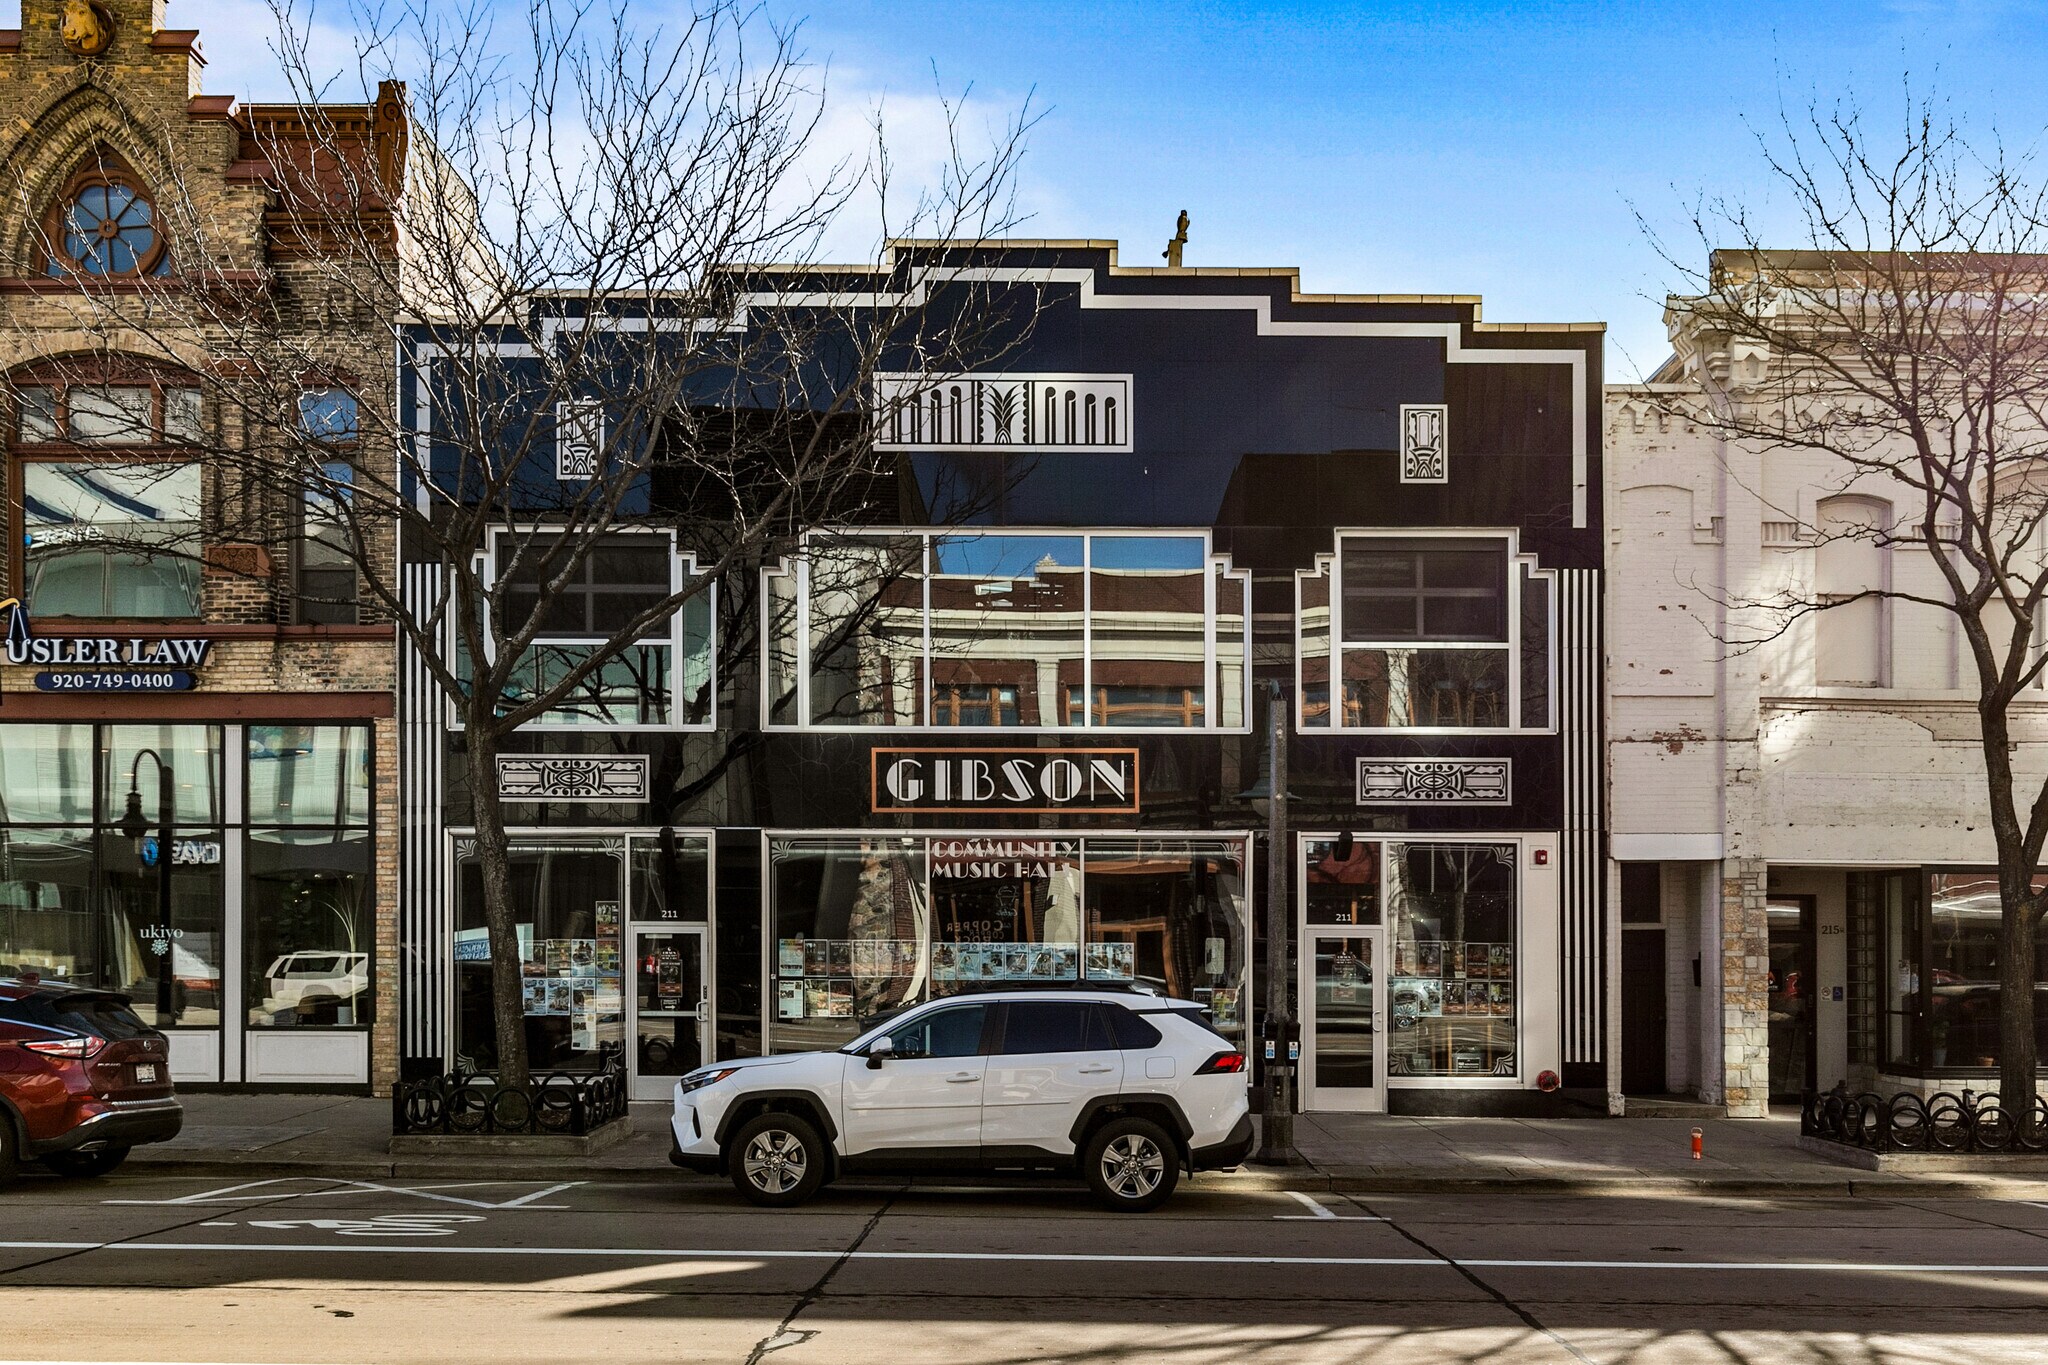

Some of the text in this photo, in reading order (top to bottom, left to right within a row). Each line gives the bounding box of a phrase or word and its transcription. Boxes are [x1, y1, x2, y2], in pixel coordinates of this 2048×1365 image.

[5, 638, 208, 664] USLER LAW
[52, 674, 174, 688] 920-749-0400
[886, 758, 1126, 802] GIBSON
[931, 841, 1077, 858] COMMUNITY
[931, 861, 1007, 878] MUSIC
[661, 910, 678, 918] 211
[1335, 913, 1352, 922] 211
[140, 924, 184, 943] ukiyo
